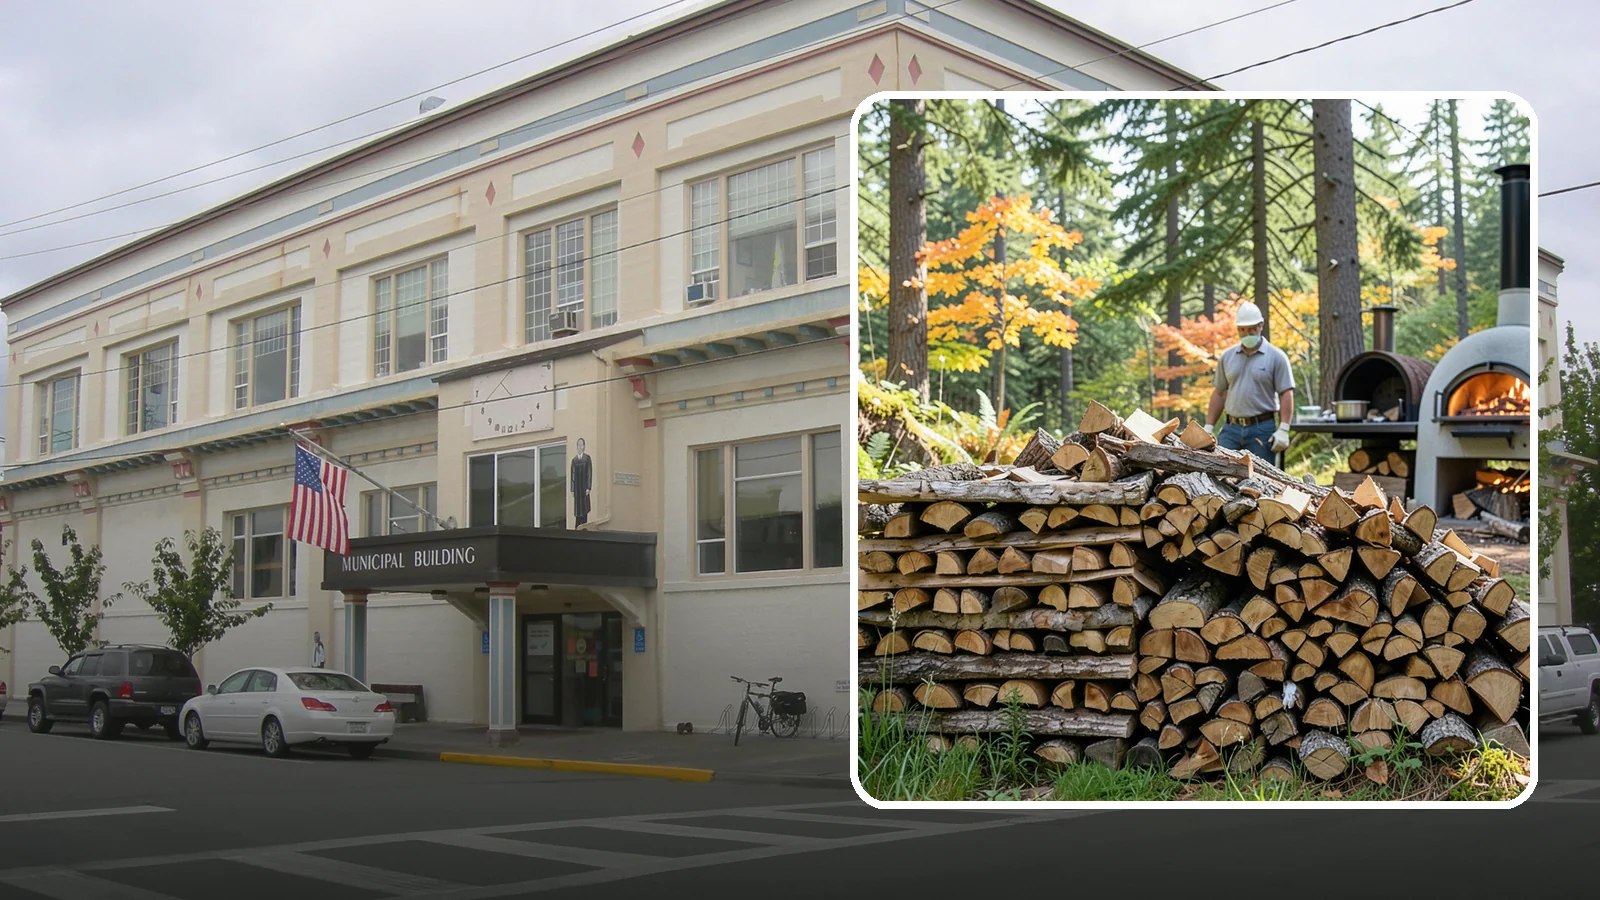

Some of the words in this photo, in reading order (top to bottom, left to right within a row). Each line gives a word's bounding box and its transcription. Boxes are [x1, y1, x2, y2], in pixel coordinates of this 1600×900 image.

[547, 362, 552, 370] 6
[488, 418, 492, 426] 9
[494, 424, 500, 432] 10
[508, 425, 513, 433] 12
[342, 552, 405, 572] MUNICIPAL
[414, 546, 475, 567] BUILDING
